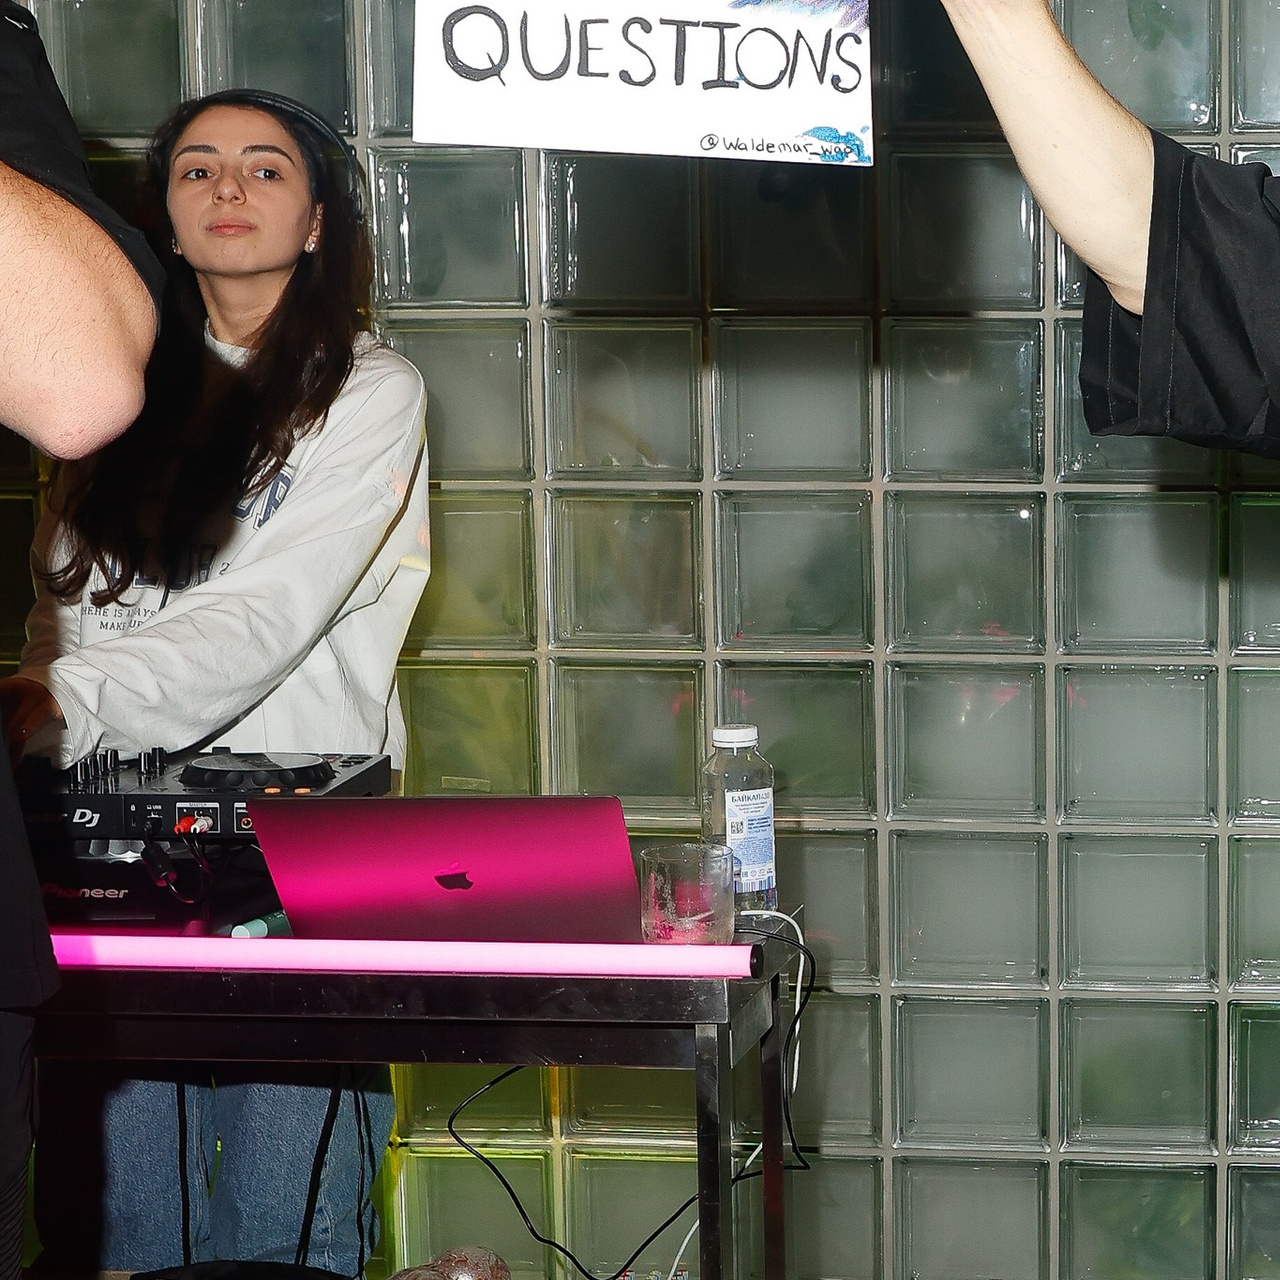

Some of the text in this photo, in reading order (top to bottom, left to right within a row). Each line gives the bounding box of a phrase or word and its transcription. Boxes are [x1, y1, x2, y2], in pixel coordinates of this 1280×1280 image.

[442, 5, 863, 94] QUESTIONS
[113, 608, 124, 618] IS
[71, 808, 101, 828] DJ
